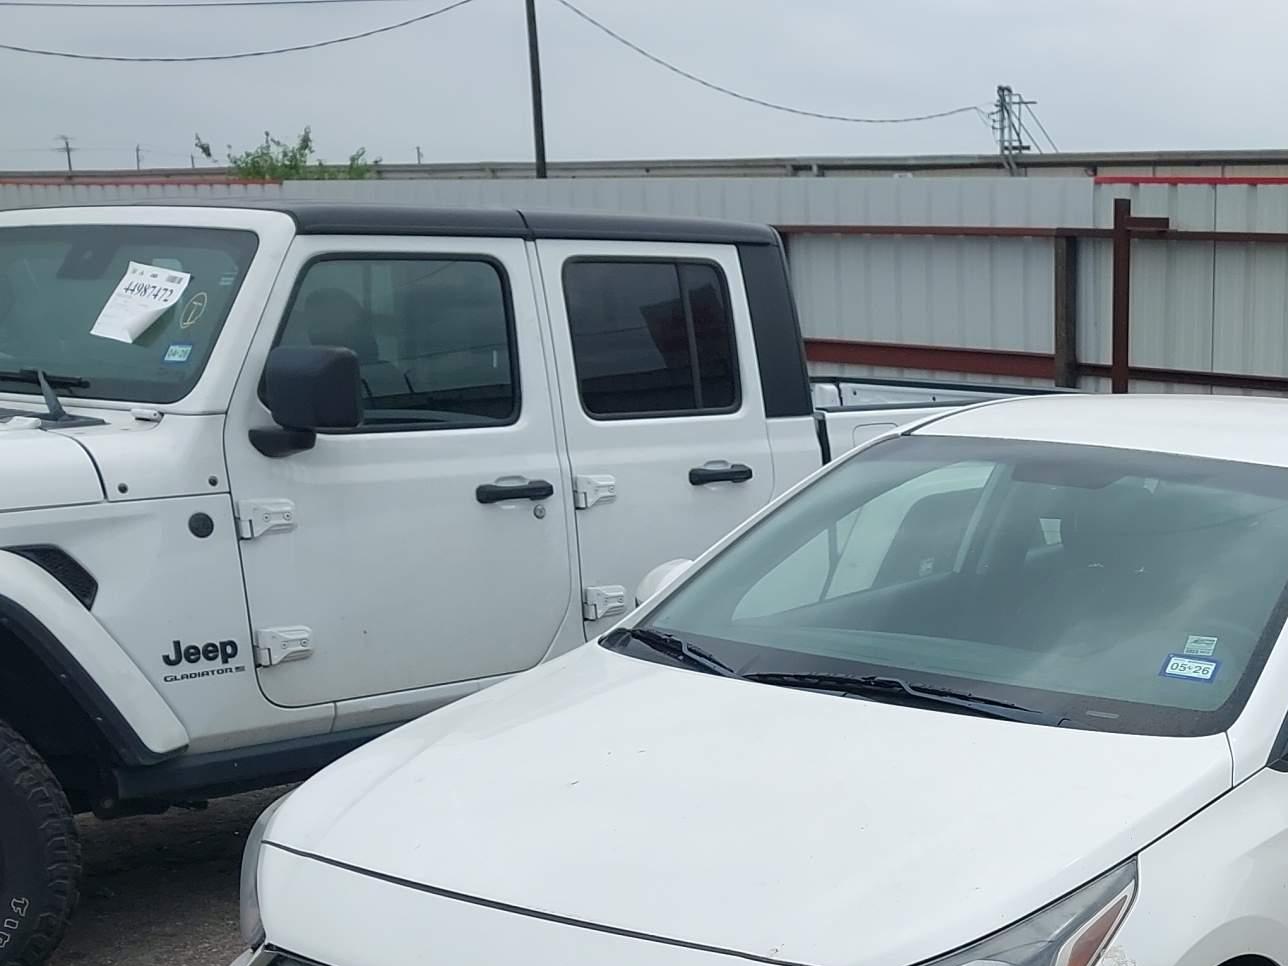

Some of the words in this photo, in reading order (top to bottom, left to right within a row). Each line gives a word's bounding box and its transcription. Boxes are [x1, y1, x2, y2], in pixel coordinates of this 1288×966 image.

[123, 281, 174, 302] 44987472
[161, 639, 239, 667] Jeep
[163, 667, 234, 683] GLADIATOR
